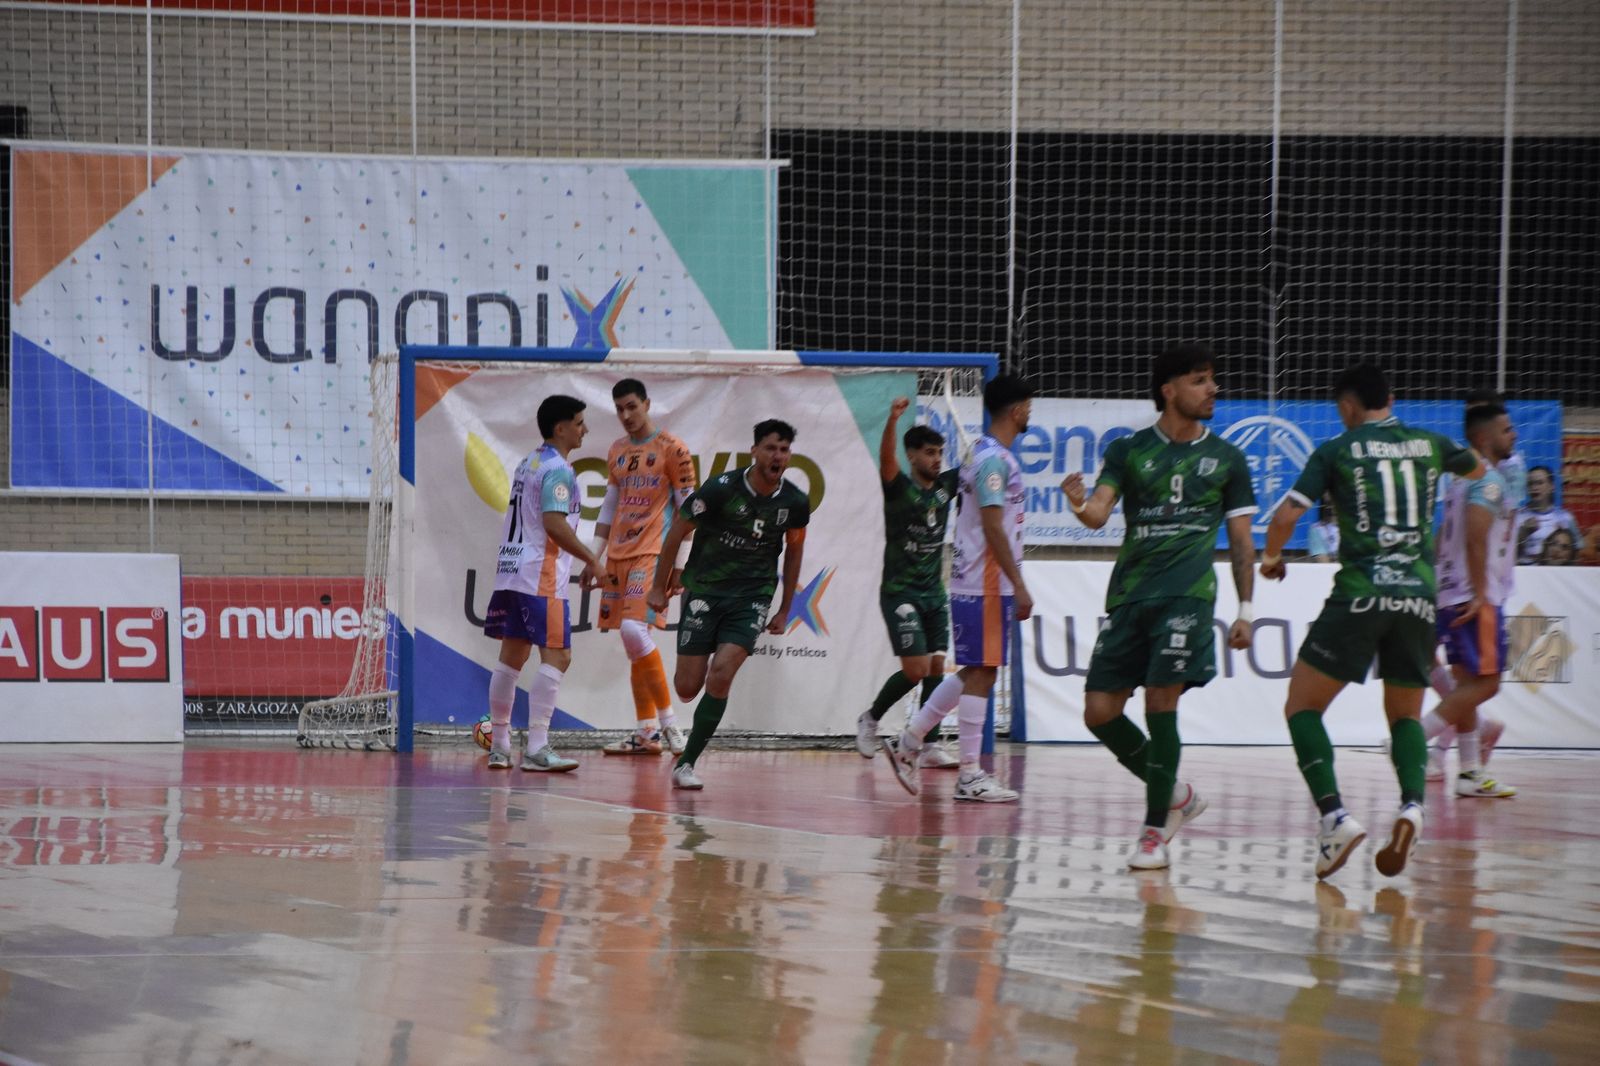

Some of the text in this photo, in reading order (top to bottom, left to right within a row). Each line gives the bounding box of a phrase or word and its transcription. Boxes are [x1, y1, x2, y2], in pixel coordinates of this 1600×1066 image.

[1169, 474, 1183, 504] 9
[1376, 459, 1419, 528] 11
[752, 518, 765, 538] 5
[769, 645, 783, 658] by
[216, 702, 300, 714] ZARAGOZA
